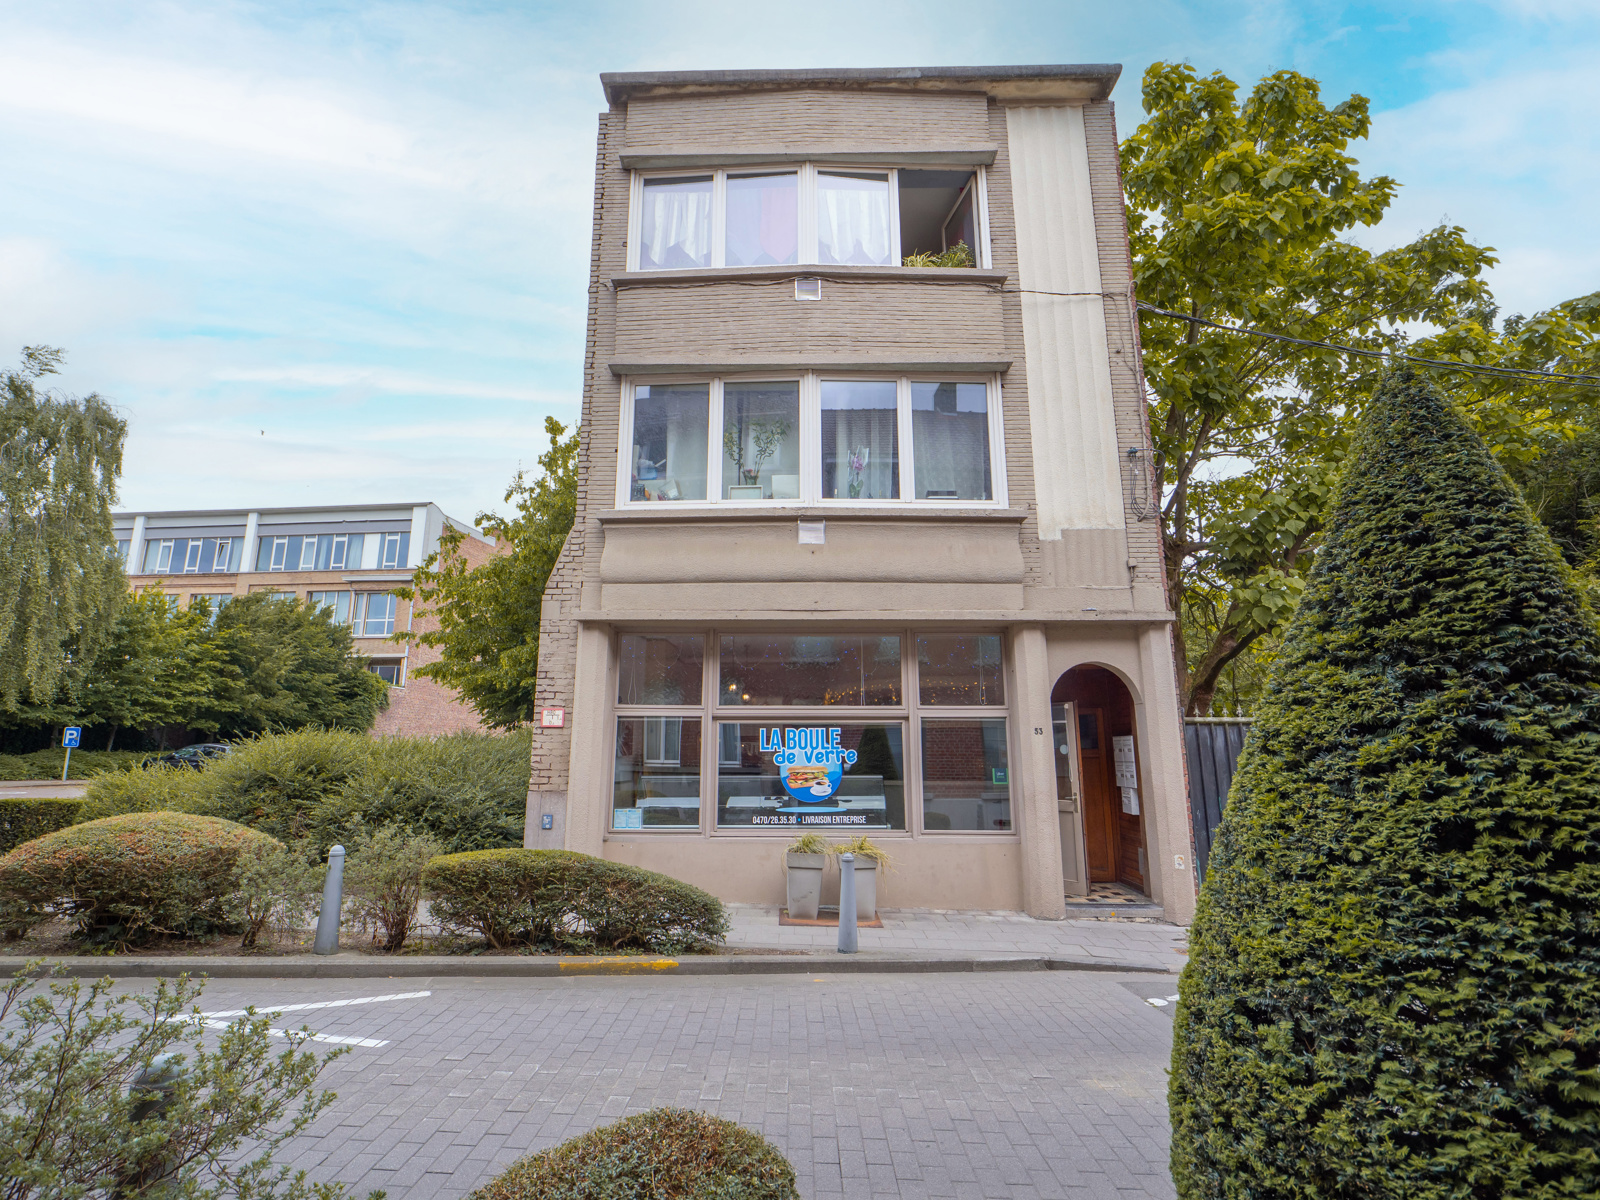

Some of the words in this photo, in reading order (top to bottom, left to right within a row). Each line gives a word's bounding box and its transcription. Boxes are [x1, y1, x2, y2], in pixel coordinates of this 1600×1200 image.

[65, 730, 77, 744] P
[1034, 727, 1043, 735] 53
[760, 728, 781, 751] LA
[785, 728, 841, 750] BOULE
[773, 748, 797, 765] de
[752, 816, 797, 824] 0470/26.35.30
[802, 816, 832, 824] LIVRAISON
[832, 816, 867, 824] ENTREPRISE
